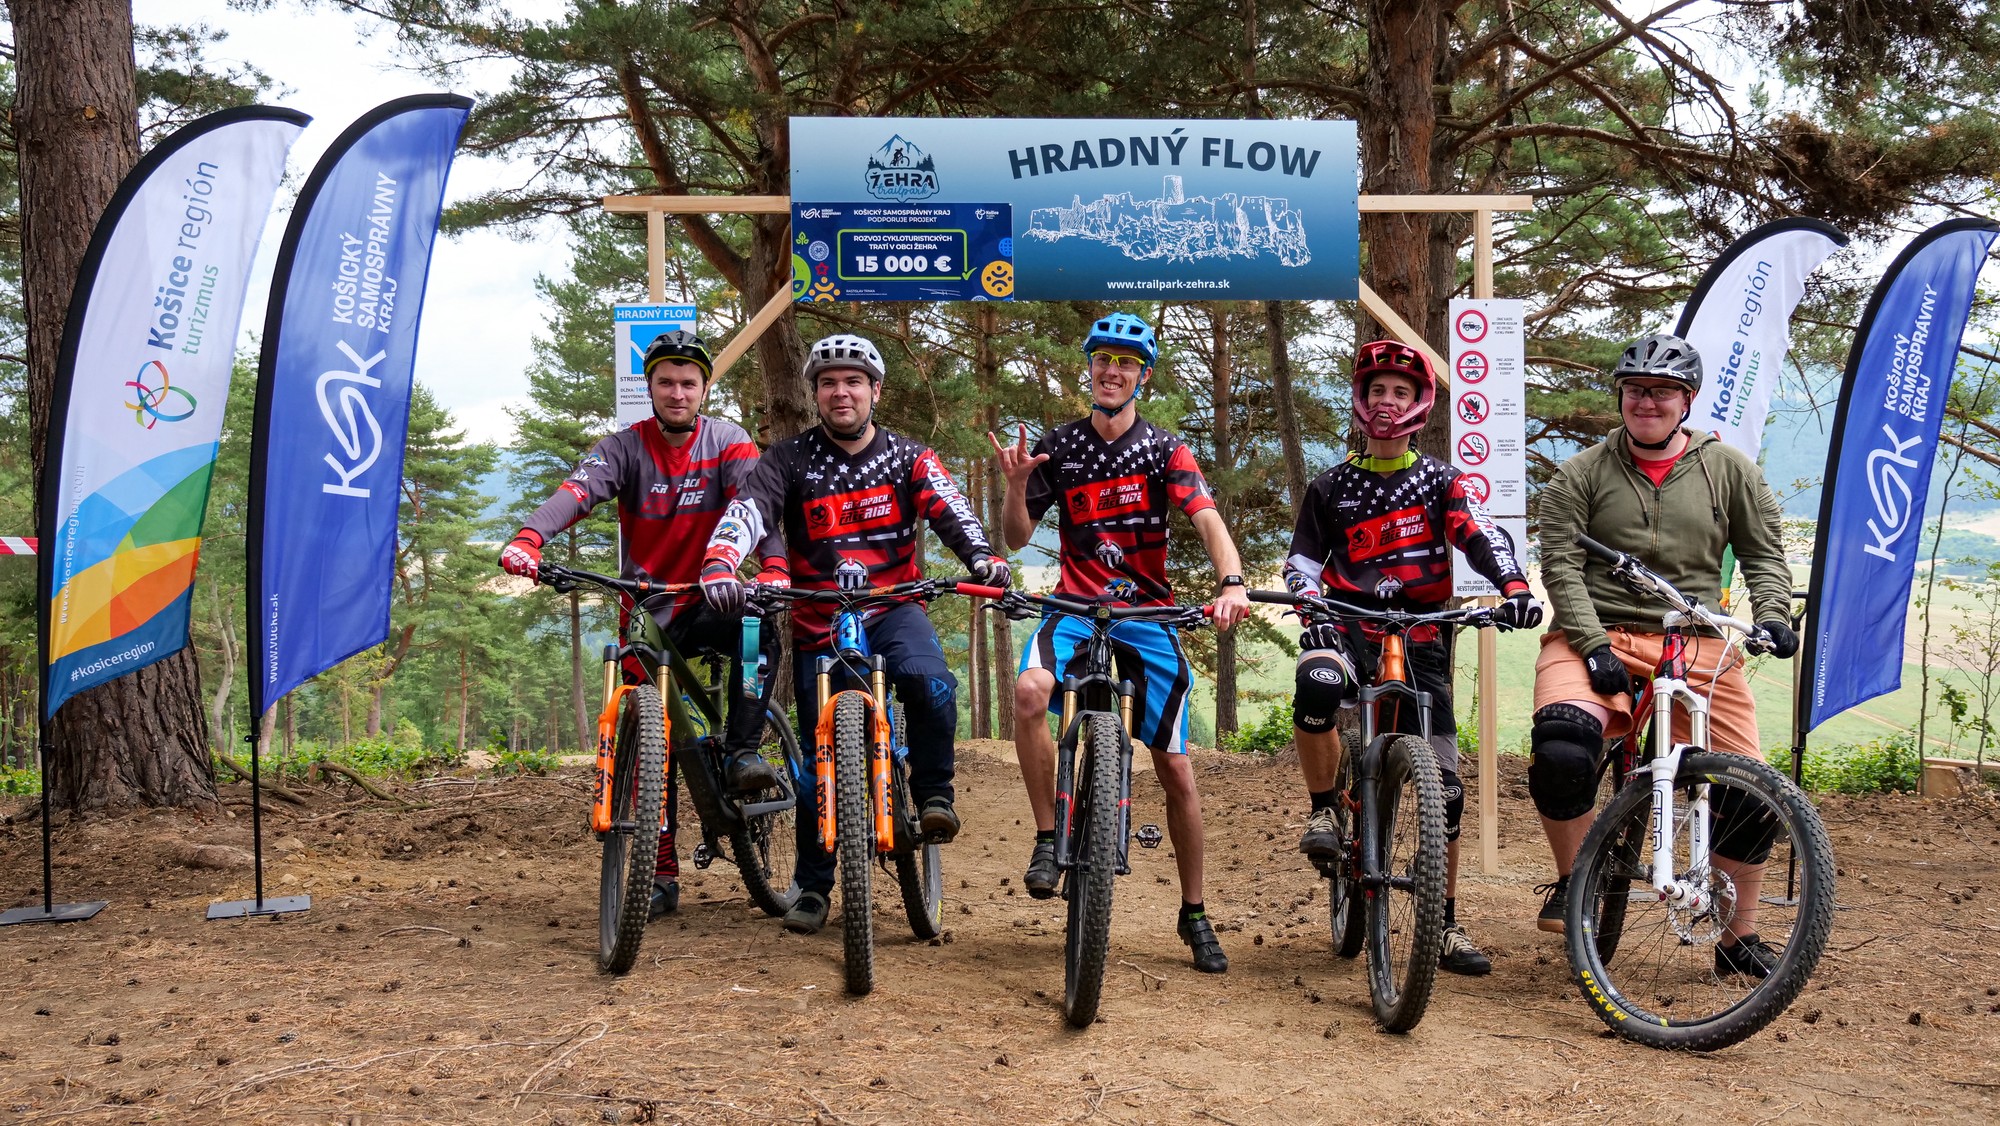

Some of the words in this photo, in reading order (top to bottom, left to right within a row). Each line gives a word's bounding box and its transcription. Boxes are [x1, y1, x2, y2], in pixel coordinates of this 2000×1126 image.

[1008, 127, 1189, 179] HRADNÝ
[1202, 136, 1321, 179] FLOW
[870, 172, 935, 189] ŽEHRA
[876, 183, 929, 198] trailpark
[853, 208, 881, 216] KOŠICKÝ
[882, 208, 933, 216] SAMOSPRÁVNY
[148, 254, 193, 350] Košice
[177, 160, 219, 254] región
[356, 171, 398, 329] SAMOSPRÁVNY
[855, 255, 878, 272] 15
[884, 255, 928, 272] 000
[934, 255, 951, 272] €
[882, 234, 953, 242] CYKLOTURISTICKÝCH
[333, 231, 365, 324] KOŠICKÝ
[1107, 278, 1230, 291] www.trailpark-zehra.sk
[183, 264, 219, 354] turizmus
[379, 276, 398, 334] KRAJ
[616, 308, 661, 319] HRADNÝ
[664, 309, 694, 318] FLOW
[1710, 341, 1745, 423] Košice
[1737, 258, 1772, 339] región
[1898, 283, 1938, 418] SAMOSPRÁVNY
[1730, 350, 1760, 427] turizmus
[1884, 332, 1908, 411] KOŠICKÝ
[1910, 373, 1932, 423] KRAJ
[70, 640, 155, 682] #kosiceregion
[1727, 766, 1759, 782] ARDENT
[1581, 969, 1627, 1020] MAXXIS
